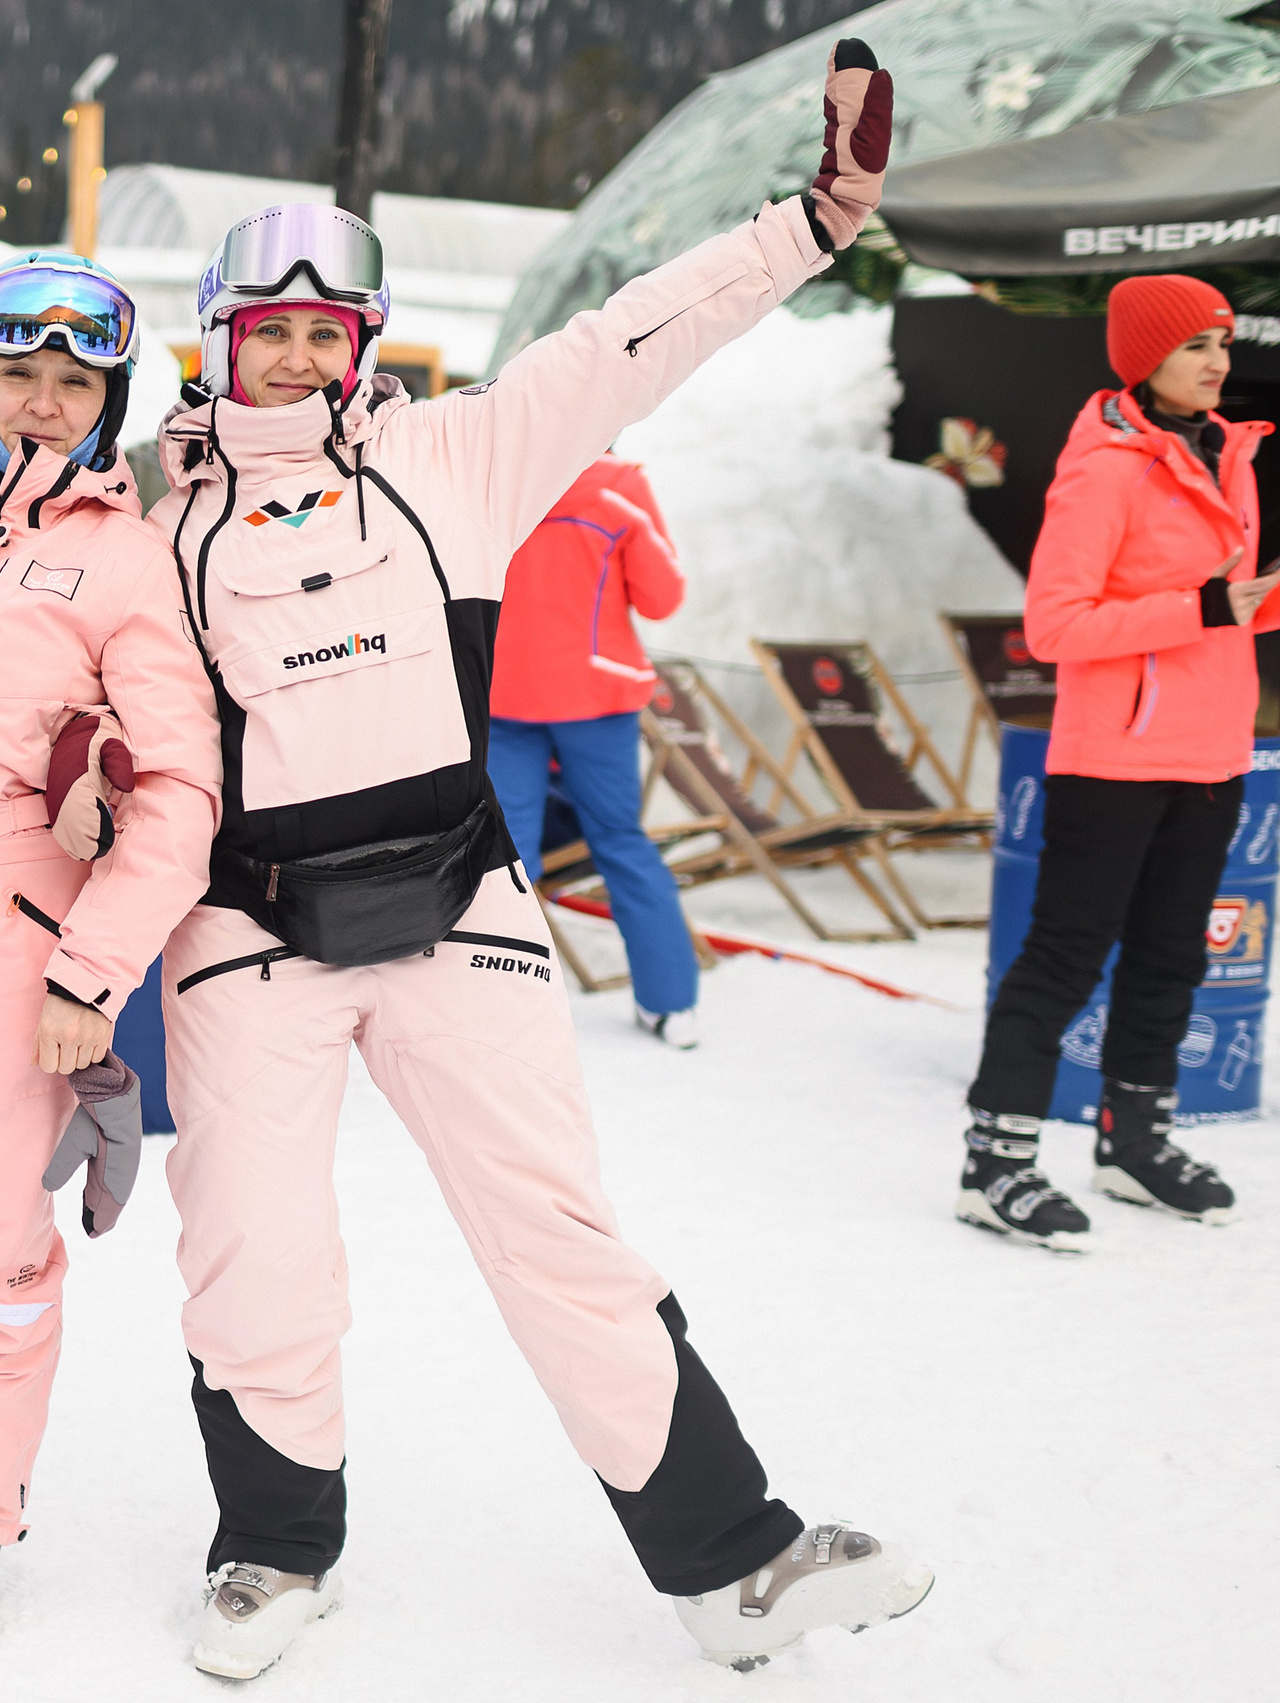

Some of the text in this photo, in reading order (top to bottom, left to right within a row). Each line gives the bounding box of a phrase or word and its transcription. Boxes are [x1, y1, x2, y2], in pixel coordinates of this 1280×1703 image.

[1063, 213, 1280, 256] ВЕЧЕРИН
[470, 954, 551, 983] SNOW HQ
